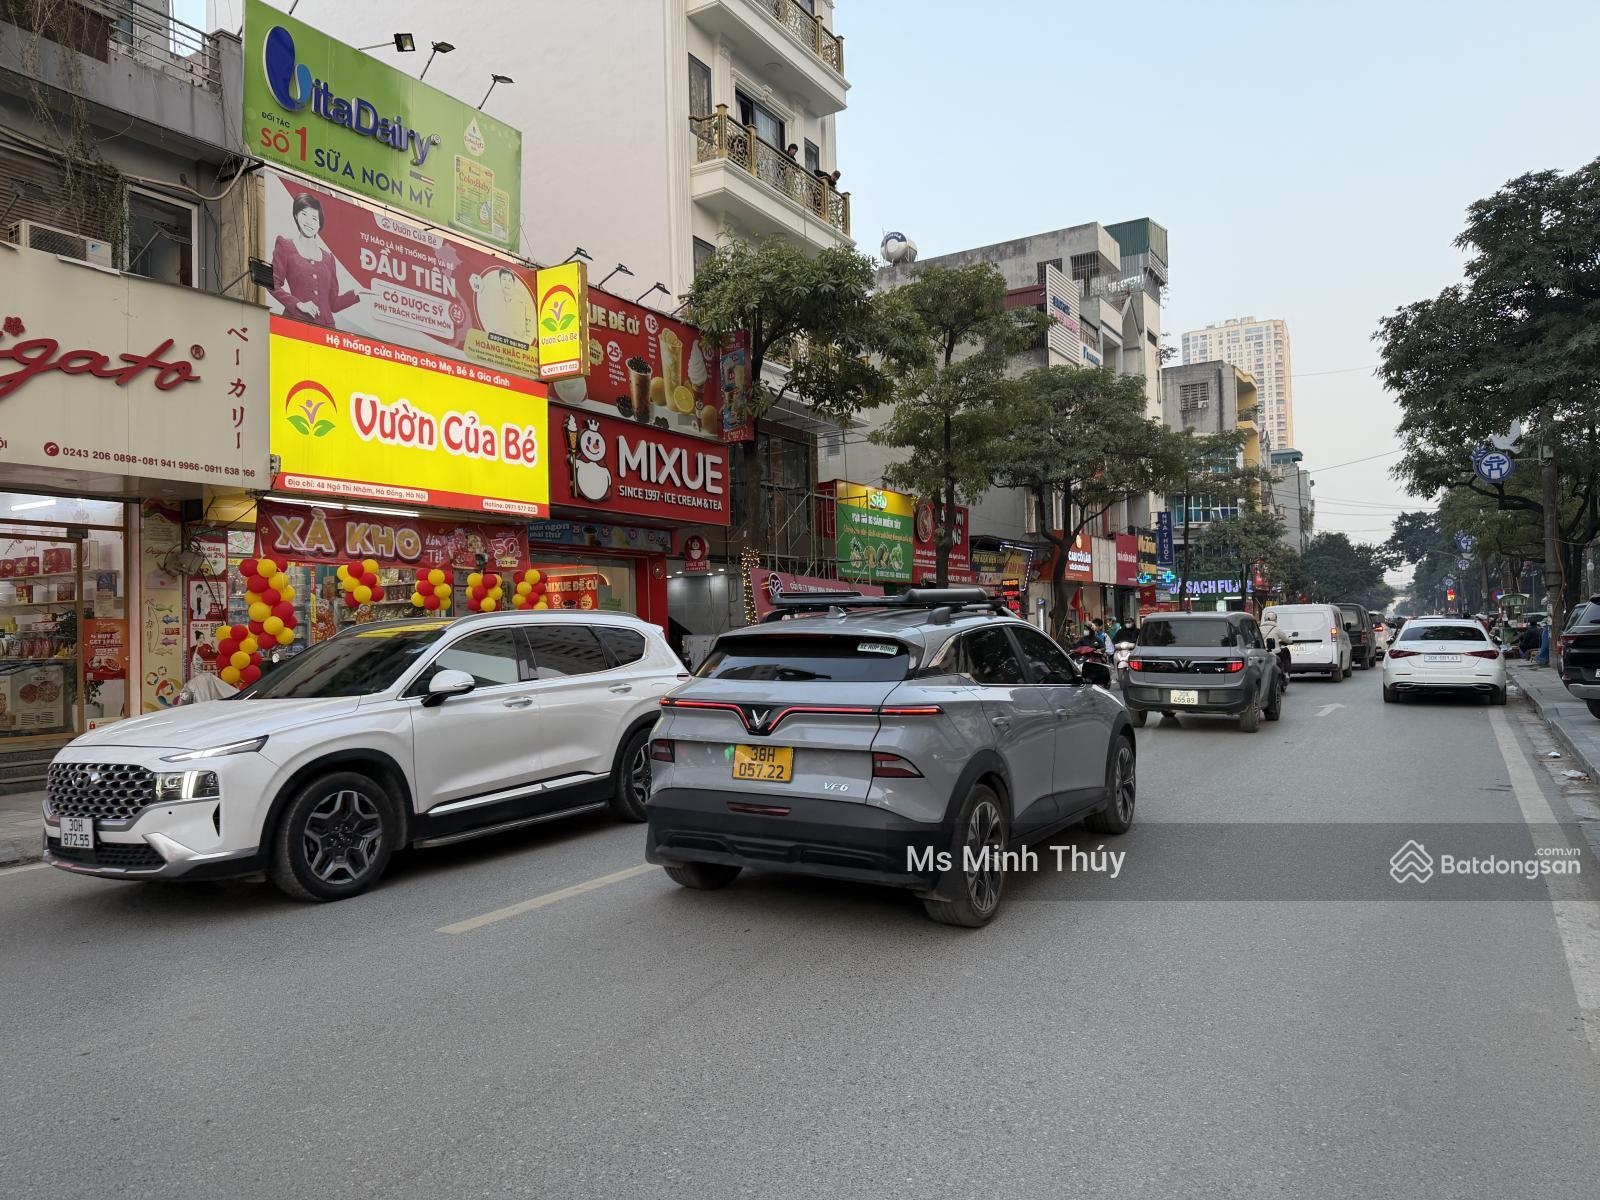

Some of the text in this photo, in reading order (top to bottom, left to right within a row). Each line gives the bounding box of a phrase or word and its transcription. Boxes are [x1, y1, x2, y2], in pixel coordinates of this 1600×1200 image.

[261, 111, 275, 122] ĐỐI
[260, 127, 290, 154] SỐ
[295, 126, 307, 161] 1
[314, 148, 355, 181] SỮA
[361, 166, 403, 198] NON
[409, 185, 434, 209] MỸ
[360, 232, 370, 243] TỰ
[360, 247, 456, 298] ĐẦU TIÊN
[383, 291, 444, 317] CÓ DƯỢC SỸ
[374, 302, 451, 330] PHỤ TRÁCH CHUYÊN MÔN
[588, 302, 607, 327] UE
[647, 317, 656, 331] 15
[475, 340, 501, 353] HOÀNG
[502, 346, 521, 359] KHẮC
[609, 346, 620, 358] 25
[326, 334, 510, 387] Hệ thống cửa hàng cho Mẹ, Bé & Gia đình
[226, 326, 250, 450] ベーカリー
[353, 397, 536, 464] Vườn Của Bé
[62, 447, 89, 458] 0243
[92, 451, 111, 460] 206
[160, 459, 176, 468] 941
[224, 466, 240, 476] 638
[242, 469, 256, 477] 166
[618, 434, 724, 495] MIXUE
[288, 478, 300, 487] Địa
[376, 488, 384, 496] Hà
[406, 491, 414, 499] Hà
[416, 492, 426, 500] Nội
[619, 485, 644, 499] SINCE
[644, 489, 660, 502] 1997
[664, 492, 677, 504] ICE
[272, 507, 422, 561] XẢ KHO
[1186, 580, 1216, 597] SẠCH
[750, 747, 776, 763] 38H
[738, 762, 784, 780] 057.22
[823, 782, 849, 792] VF6
[68, 818, 84, 832] 30H
[64, 832, 90, 848] 872.55
